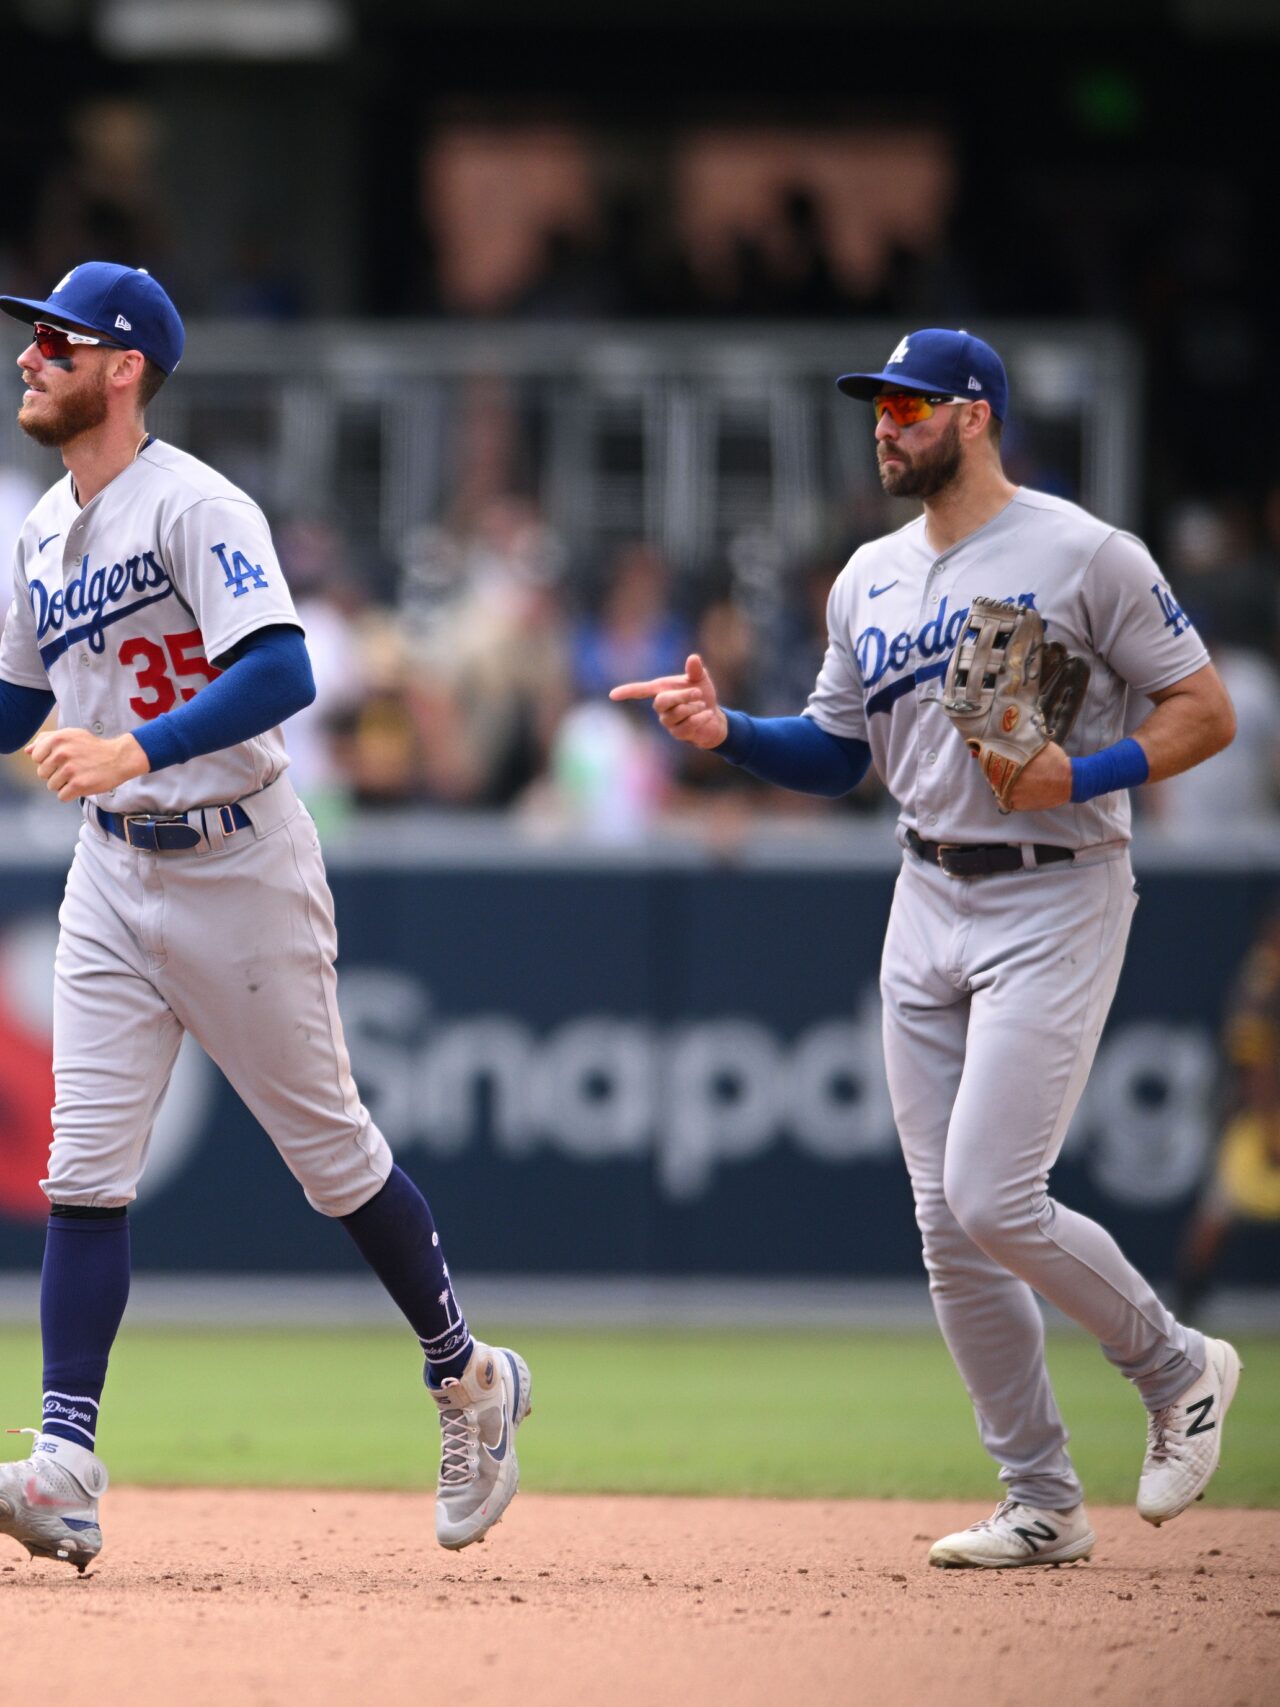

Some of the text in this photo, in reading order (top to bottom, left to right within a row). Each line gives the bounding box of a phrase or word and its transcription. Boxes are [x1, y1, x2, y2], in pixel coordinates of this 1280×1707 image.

[28, 551, 173, 654] Dodgers
[210, 542, 269, 599] LA
[118, 629, 225, 721] 35
[42, 1400, 92, 1423] Dodgers
